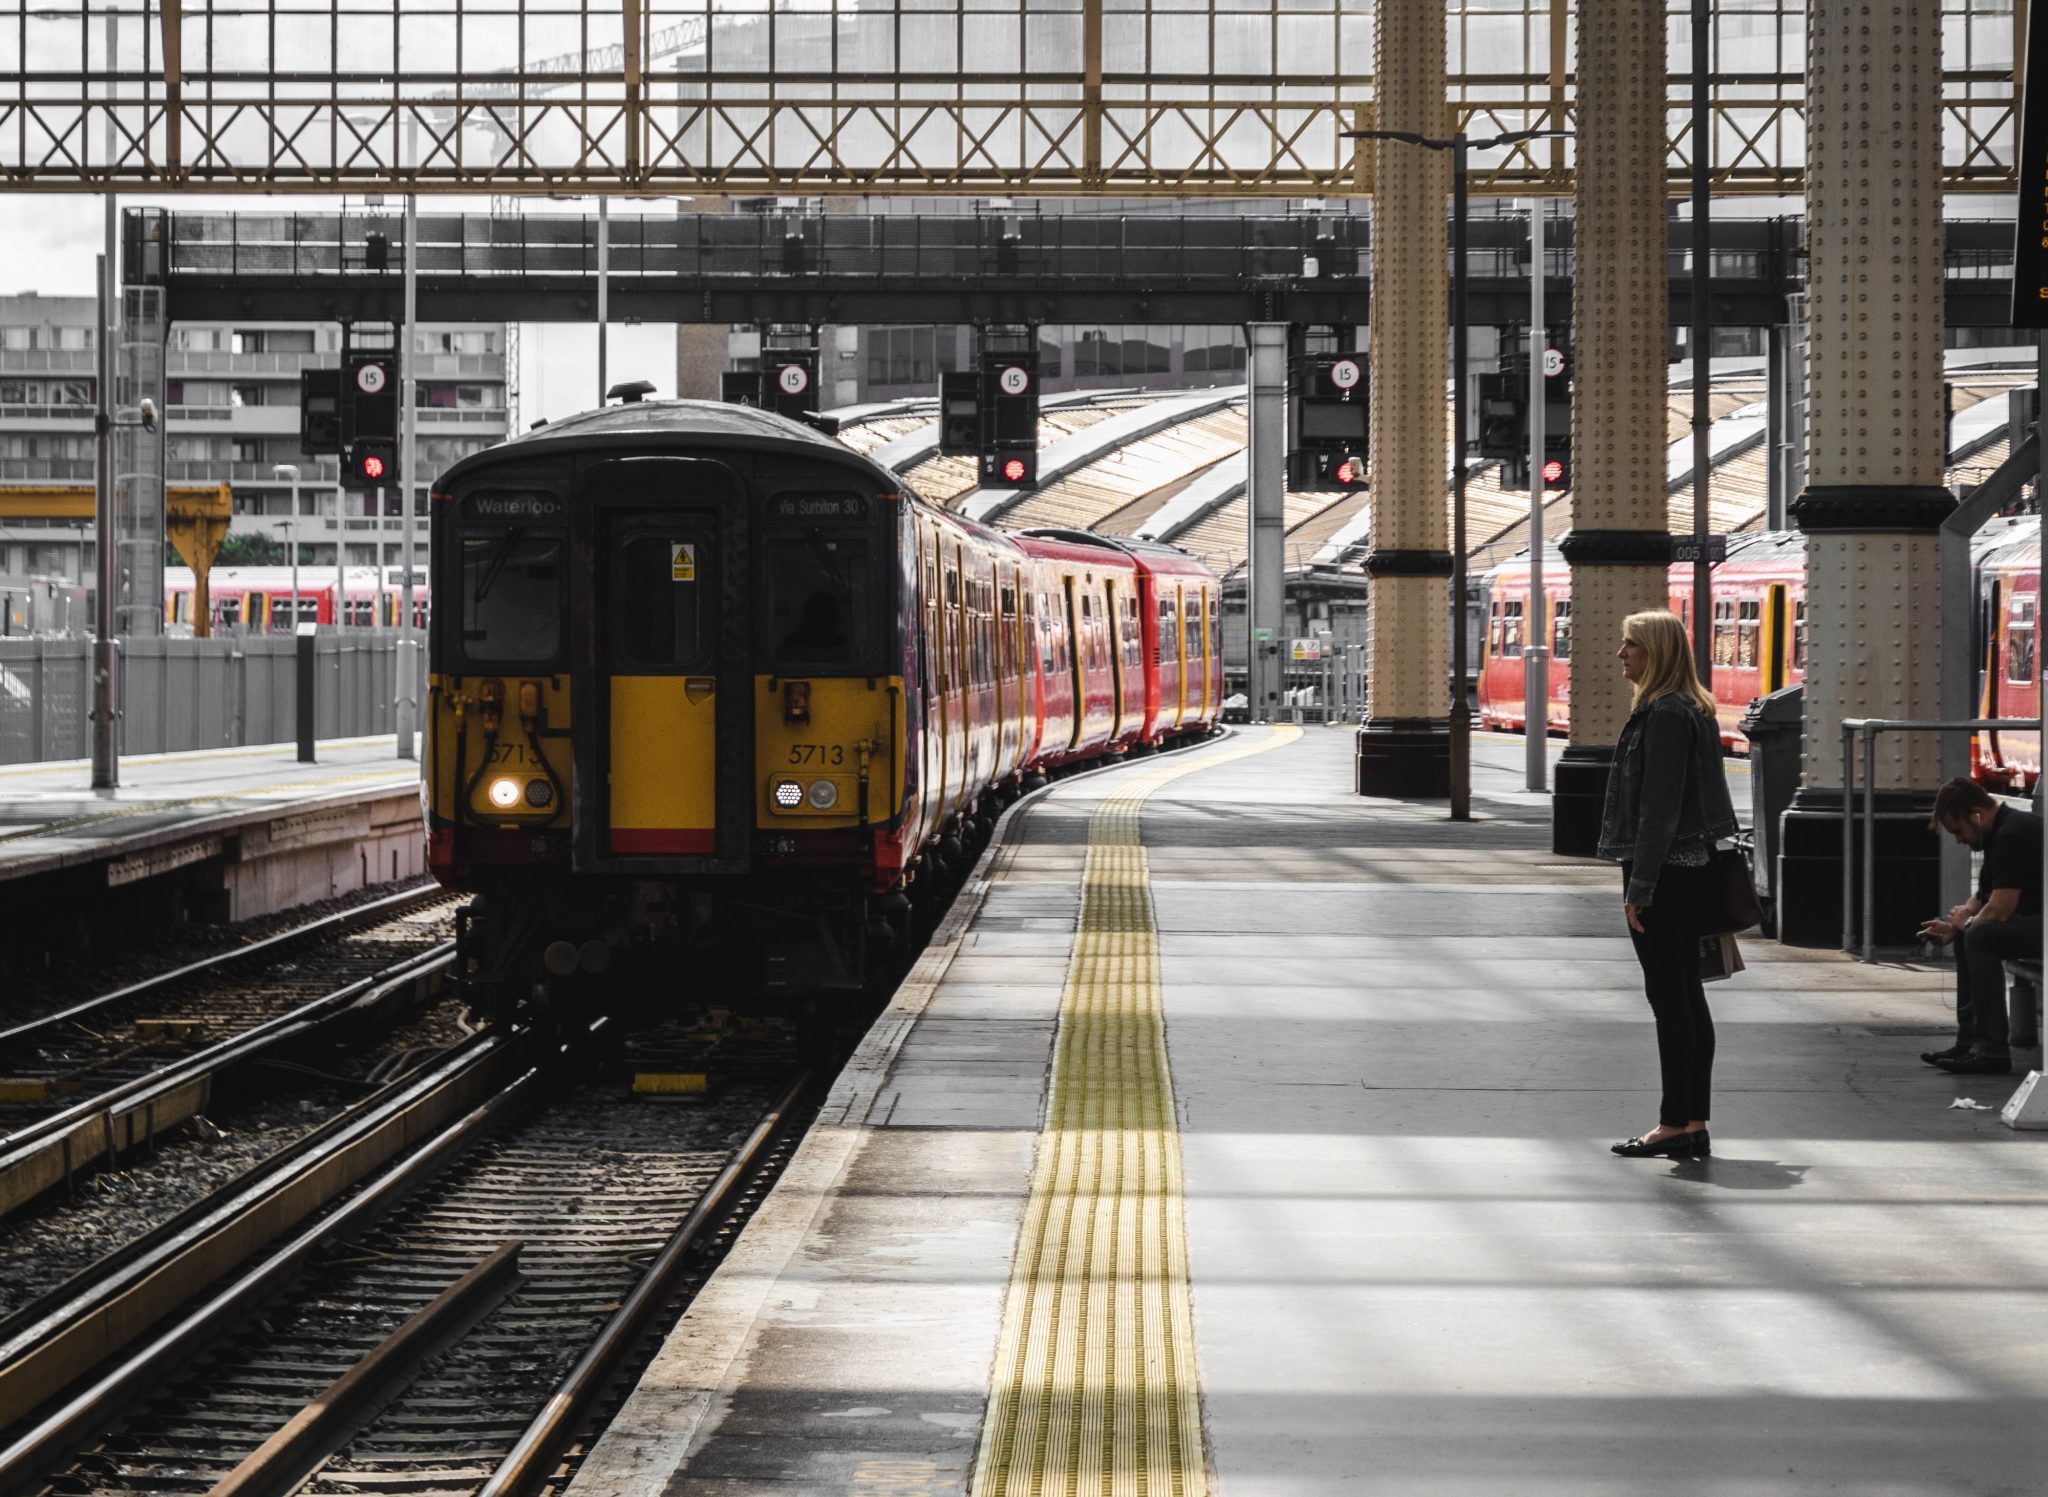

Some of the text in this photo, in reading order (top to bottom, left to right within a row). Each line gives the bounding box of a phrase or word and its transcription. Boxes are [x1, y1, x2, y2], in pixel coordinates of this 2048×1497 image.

[1546, 356, 1557, 369] 15
[365, 372, 377, 385] 15
[787, 374, 799, 386] 15
[1008, 374, 1020, 387] 15
[1339, 368, 1351, 380] 15
[475, 498, 555, 514] Waterloo
[799, 499, 840, 515] Surbiton
[844, 499, 859, 515] 30
[1676, 546, 1701, 560] 005
[788, 744, 843, 765] 5713
